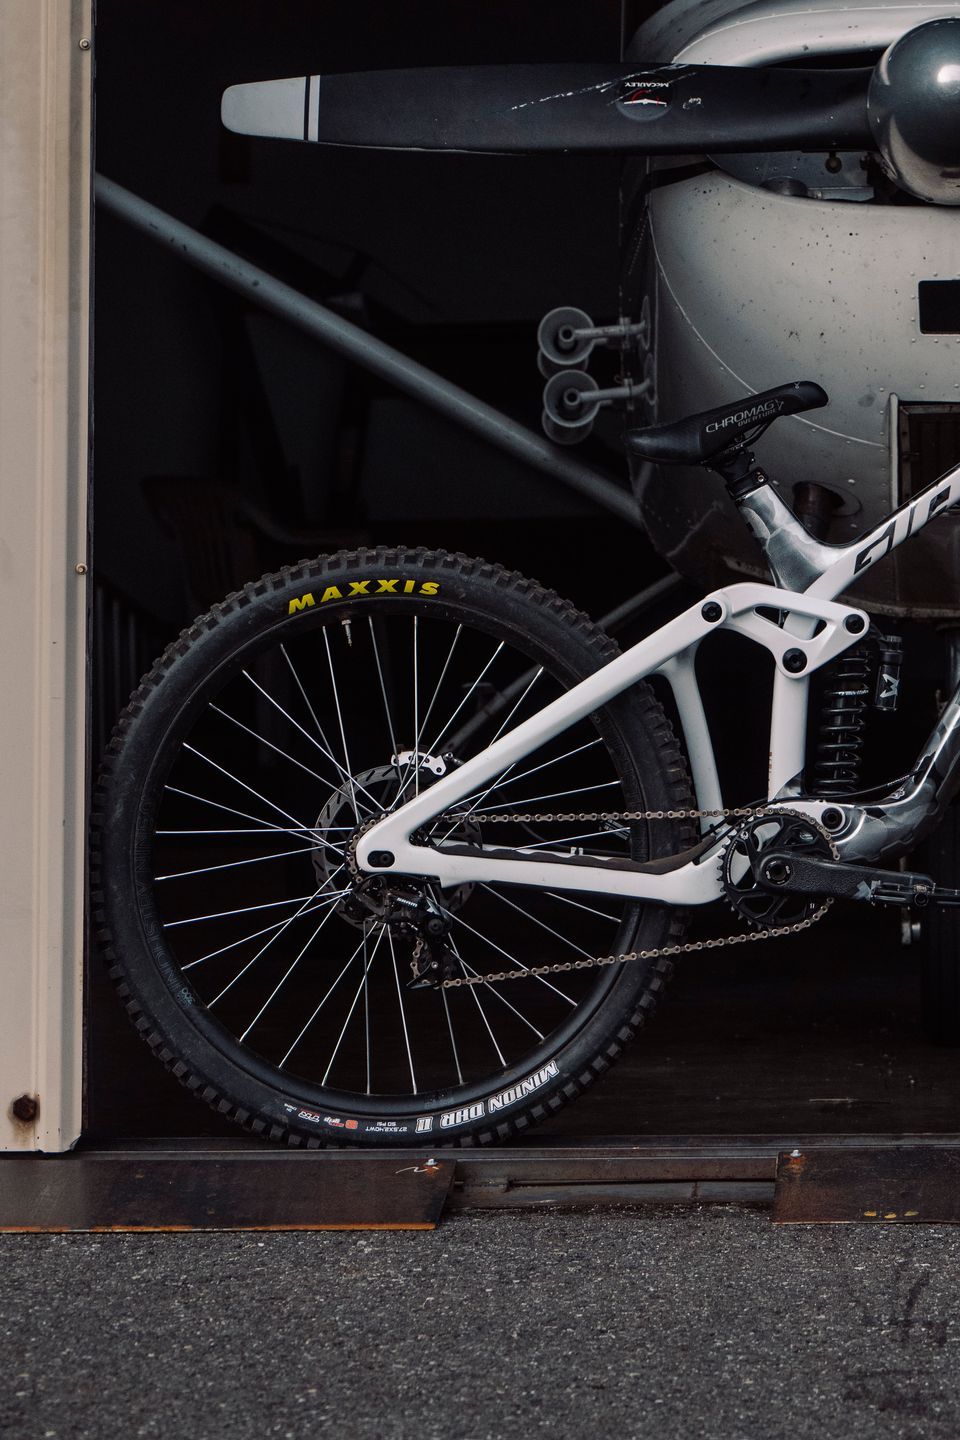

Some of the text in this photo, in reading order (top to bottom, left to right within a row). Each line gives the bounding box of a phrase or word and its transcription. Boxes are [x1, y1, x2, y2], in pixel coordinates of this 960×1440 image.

[705, 399, 777, 433] CHROMAG
[287, 579, 441, 615] MAXXIS
[488, 1060, 559, 1113] MINION
[440, 1101, 485, 1128] DHR
